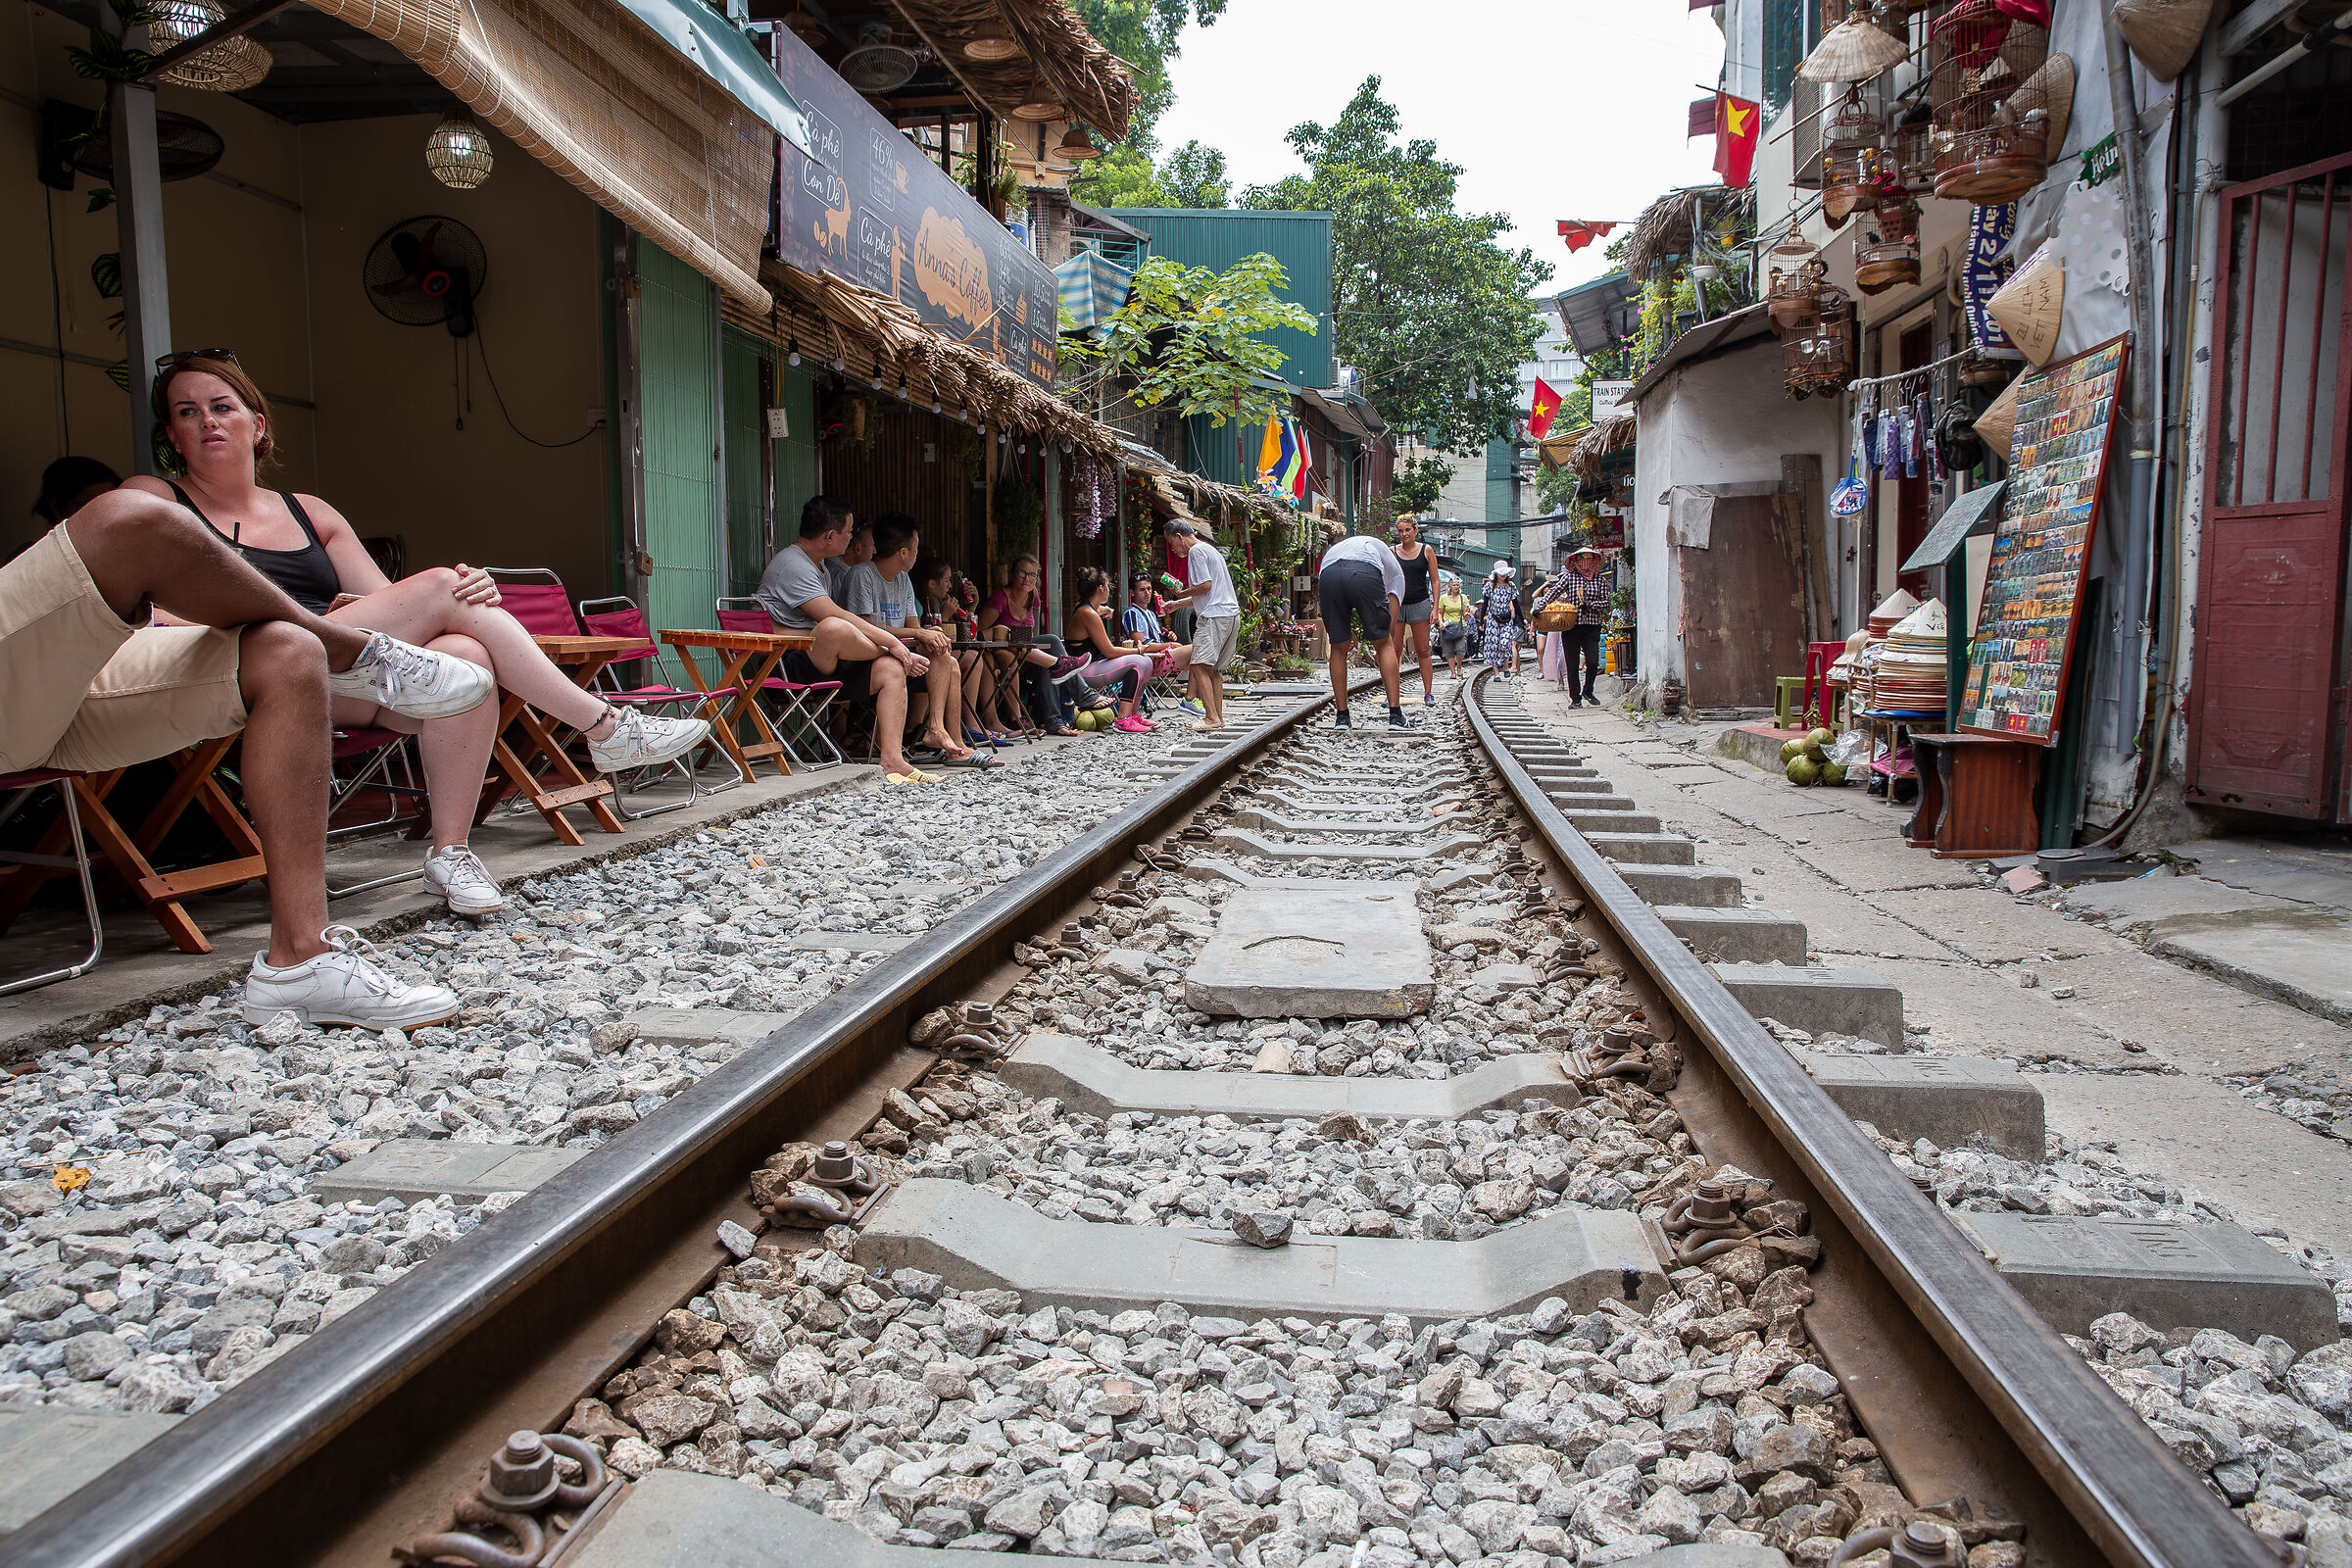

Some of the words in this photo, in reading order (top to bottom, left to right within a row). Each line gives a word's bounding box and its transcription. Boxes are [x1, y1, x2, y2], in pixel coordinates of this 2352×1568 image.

[820, 128, 840, 159] phê
[872, 135, 894, 170] 46%
[804, 159, 824, 194] Con
[2090, 145, 2119, 179] Hein
[860, 217, 874, 246] Cà
[874, 230, 892, 258] phê
[918, 226, 956, 288] Anna's
[959, 257, 989, 316] Coffee
[1592, 387, 1610, 396] TRAIN
